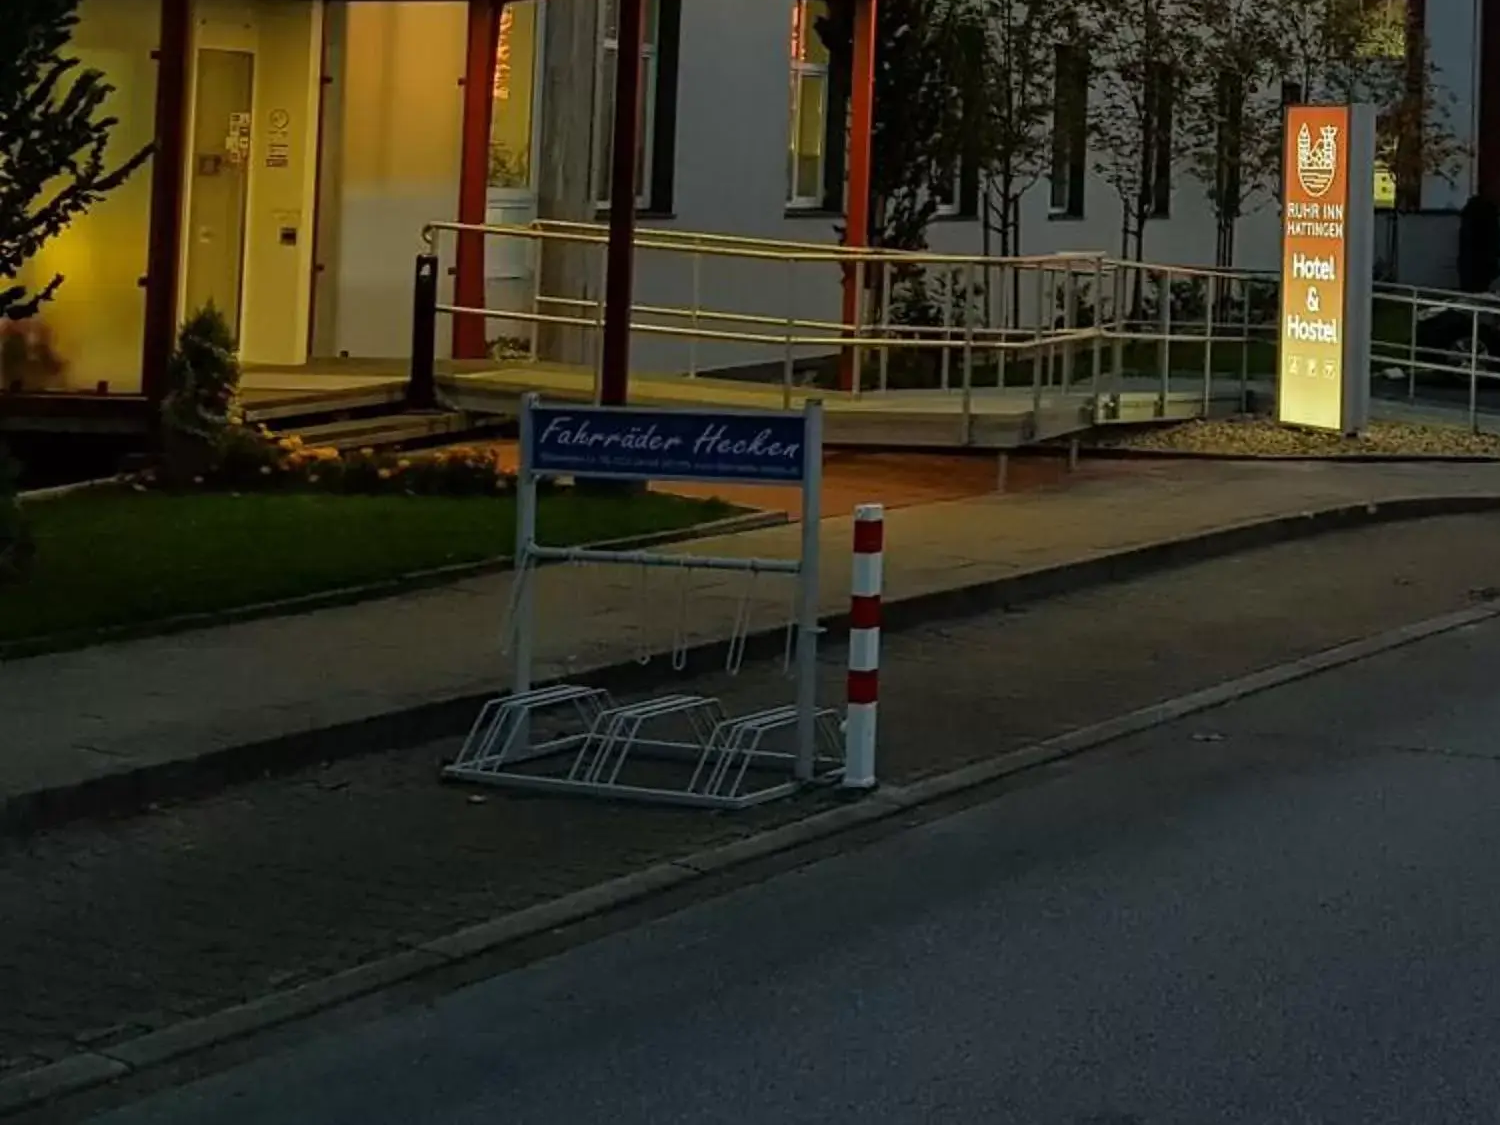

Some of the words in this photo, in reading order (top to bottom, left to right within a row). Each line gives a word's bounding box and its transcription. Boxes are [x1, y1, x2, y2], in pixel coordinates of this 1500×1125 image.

[1287, 202, 1320, 219] RUHR
[1323, 203, 1345, 221] INN
[1287, 222, 1344, 239] HATTINGEN
[1292, 252, 1336, 281] Hotel
[1305, 286, 1320, 312] &
[1287, 314, 1338, 344] Hostel
[539, 416, 683, 450] Fahrräder
